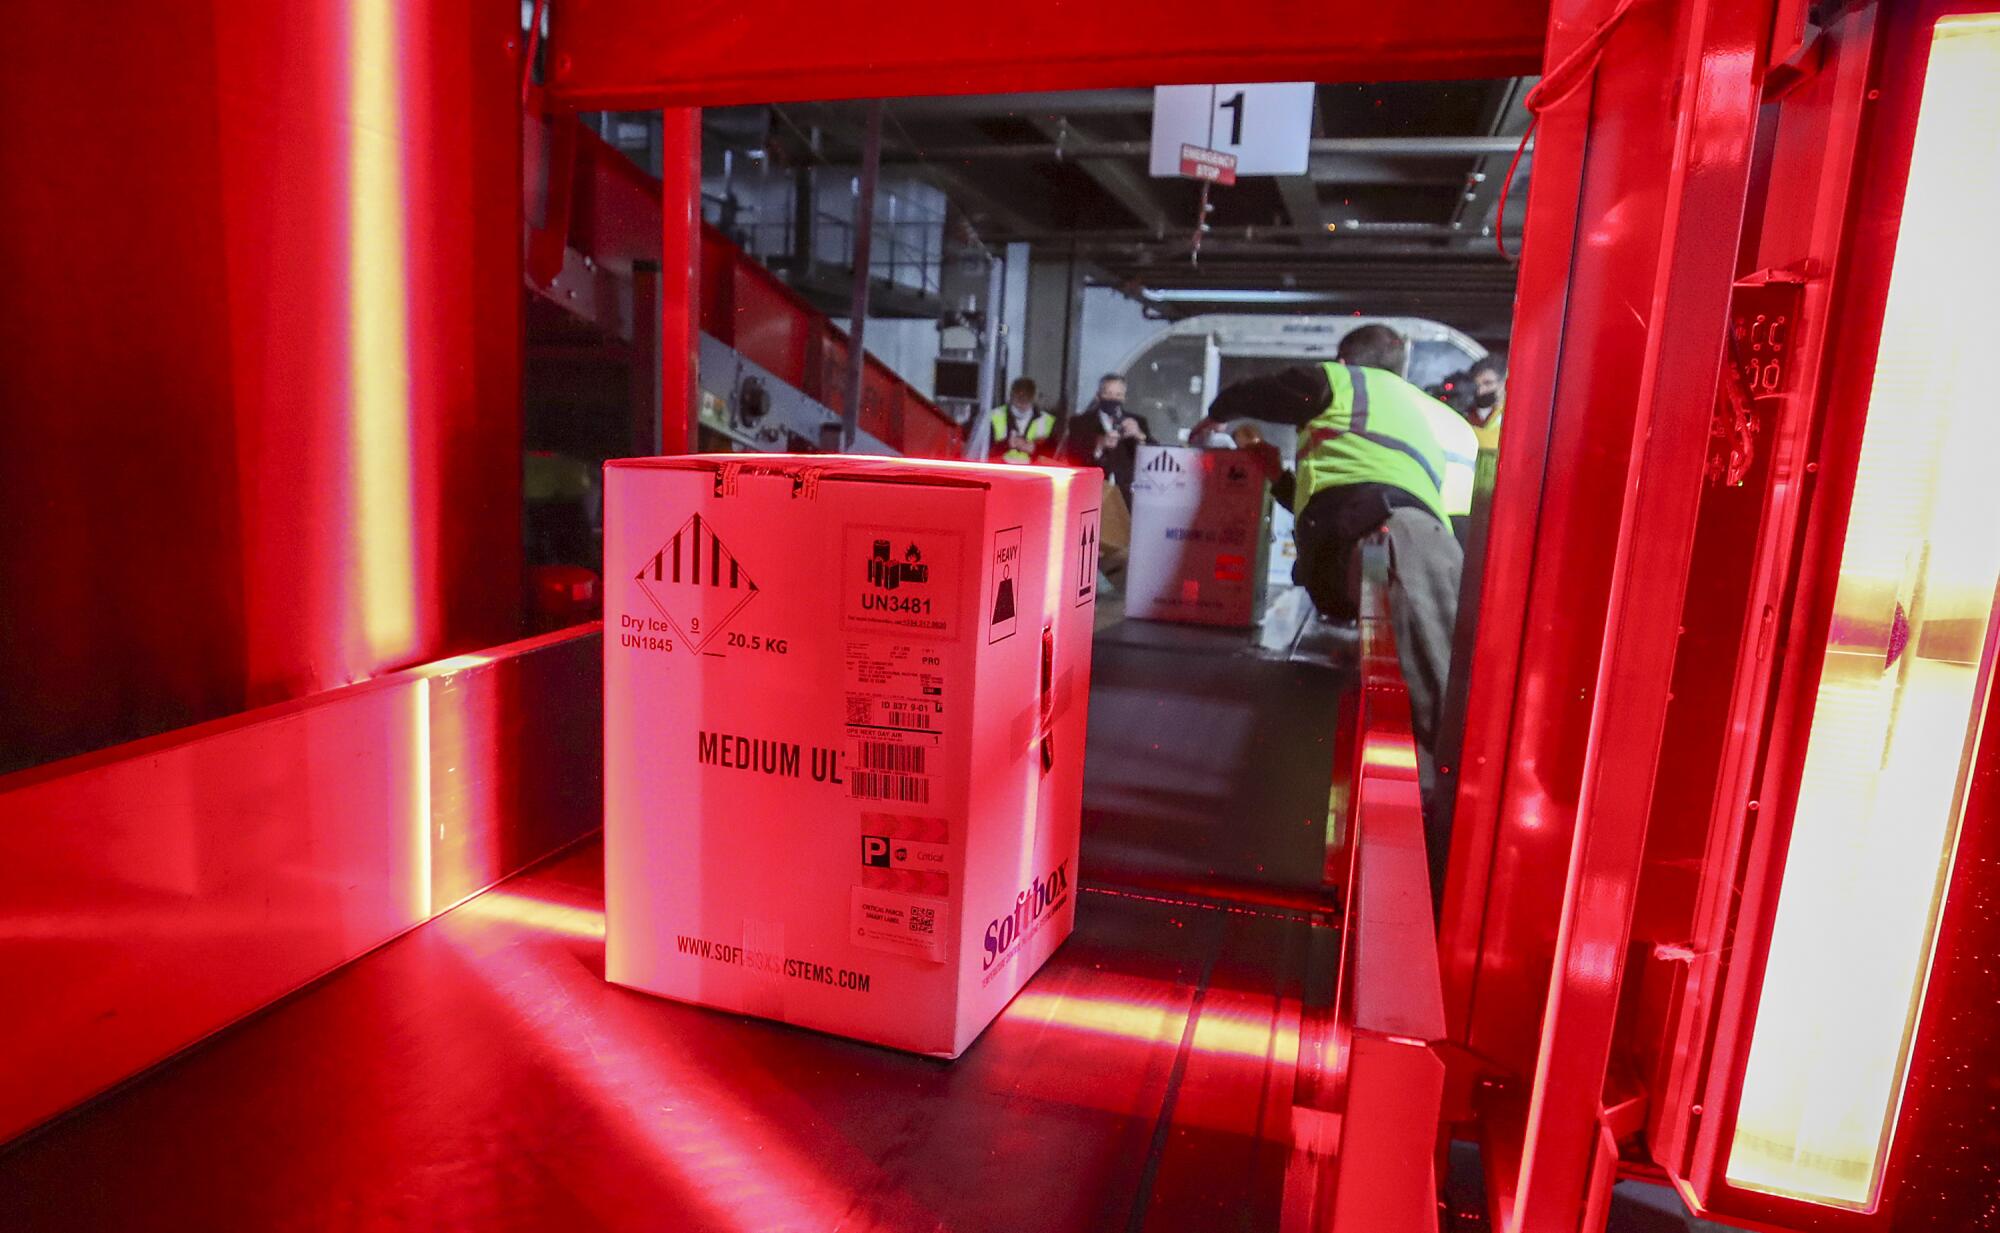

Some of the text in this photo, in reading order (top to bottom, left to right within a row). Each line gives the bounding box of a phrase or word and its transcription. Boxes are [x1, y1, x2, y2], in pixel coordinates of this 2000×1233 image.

[1219, 91, 1244, 145] 1
[1195, 165, 1220, 179] STOP
[997, 545, 1018, 564] HEAVY
[862, 593, 931, 615] UN3481
[621, 615, 668, 632] Dry Ice
[691, 618, 699, 630] 9
[621, 634, 673, 652] UN1845
[728, 632, 788, 654] 20.5 KG
[922, 657, 940, 666] PRO
[881, 701, 890, 709] ID
[699, 731, 845, 784] MEDIUM UL
[864, 837, 887, 864] P
[983, 857, 1068, 971] Softbox
